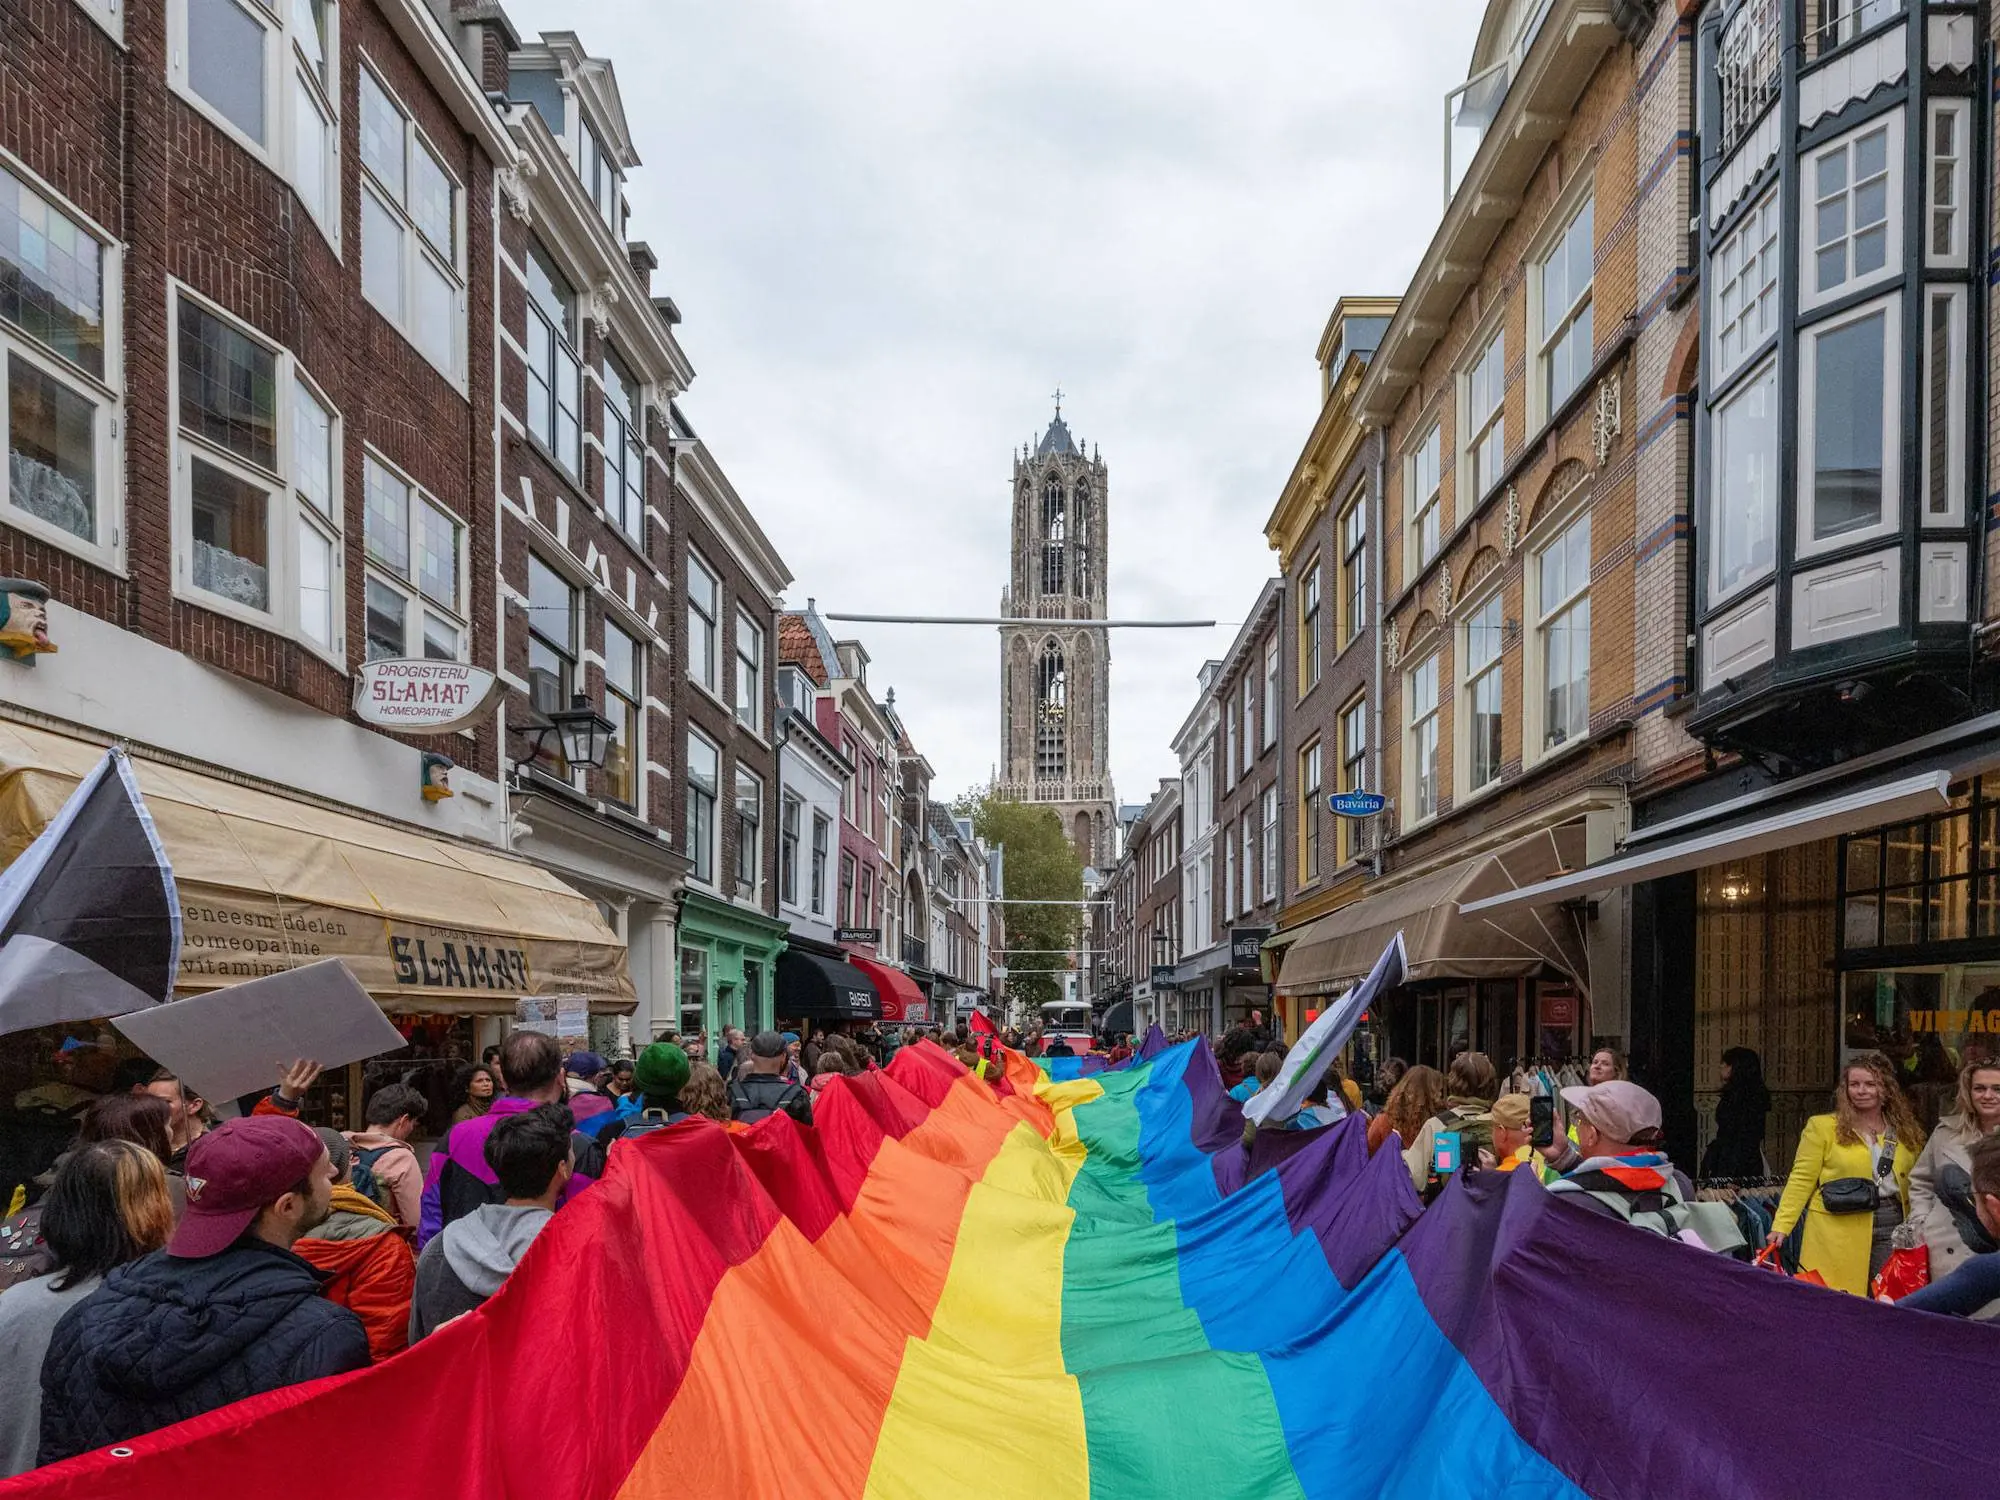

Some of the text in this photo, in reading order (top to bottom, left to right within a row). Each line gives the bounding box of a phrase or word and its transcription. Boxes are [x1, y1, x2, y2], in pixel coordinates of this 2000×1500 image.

[378, 664, 469, 680] DROGISTERIJ
[373, 680, 469, 705] SLAMAT
[380, 705, 454, 717] HOMEOPATHIE
[1336, 799, 1380, 810] Bavaria
[181, 956, 298, 976] vitamine
[391, 936, 528, 990] SLAMAT
